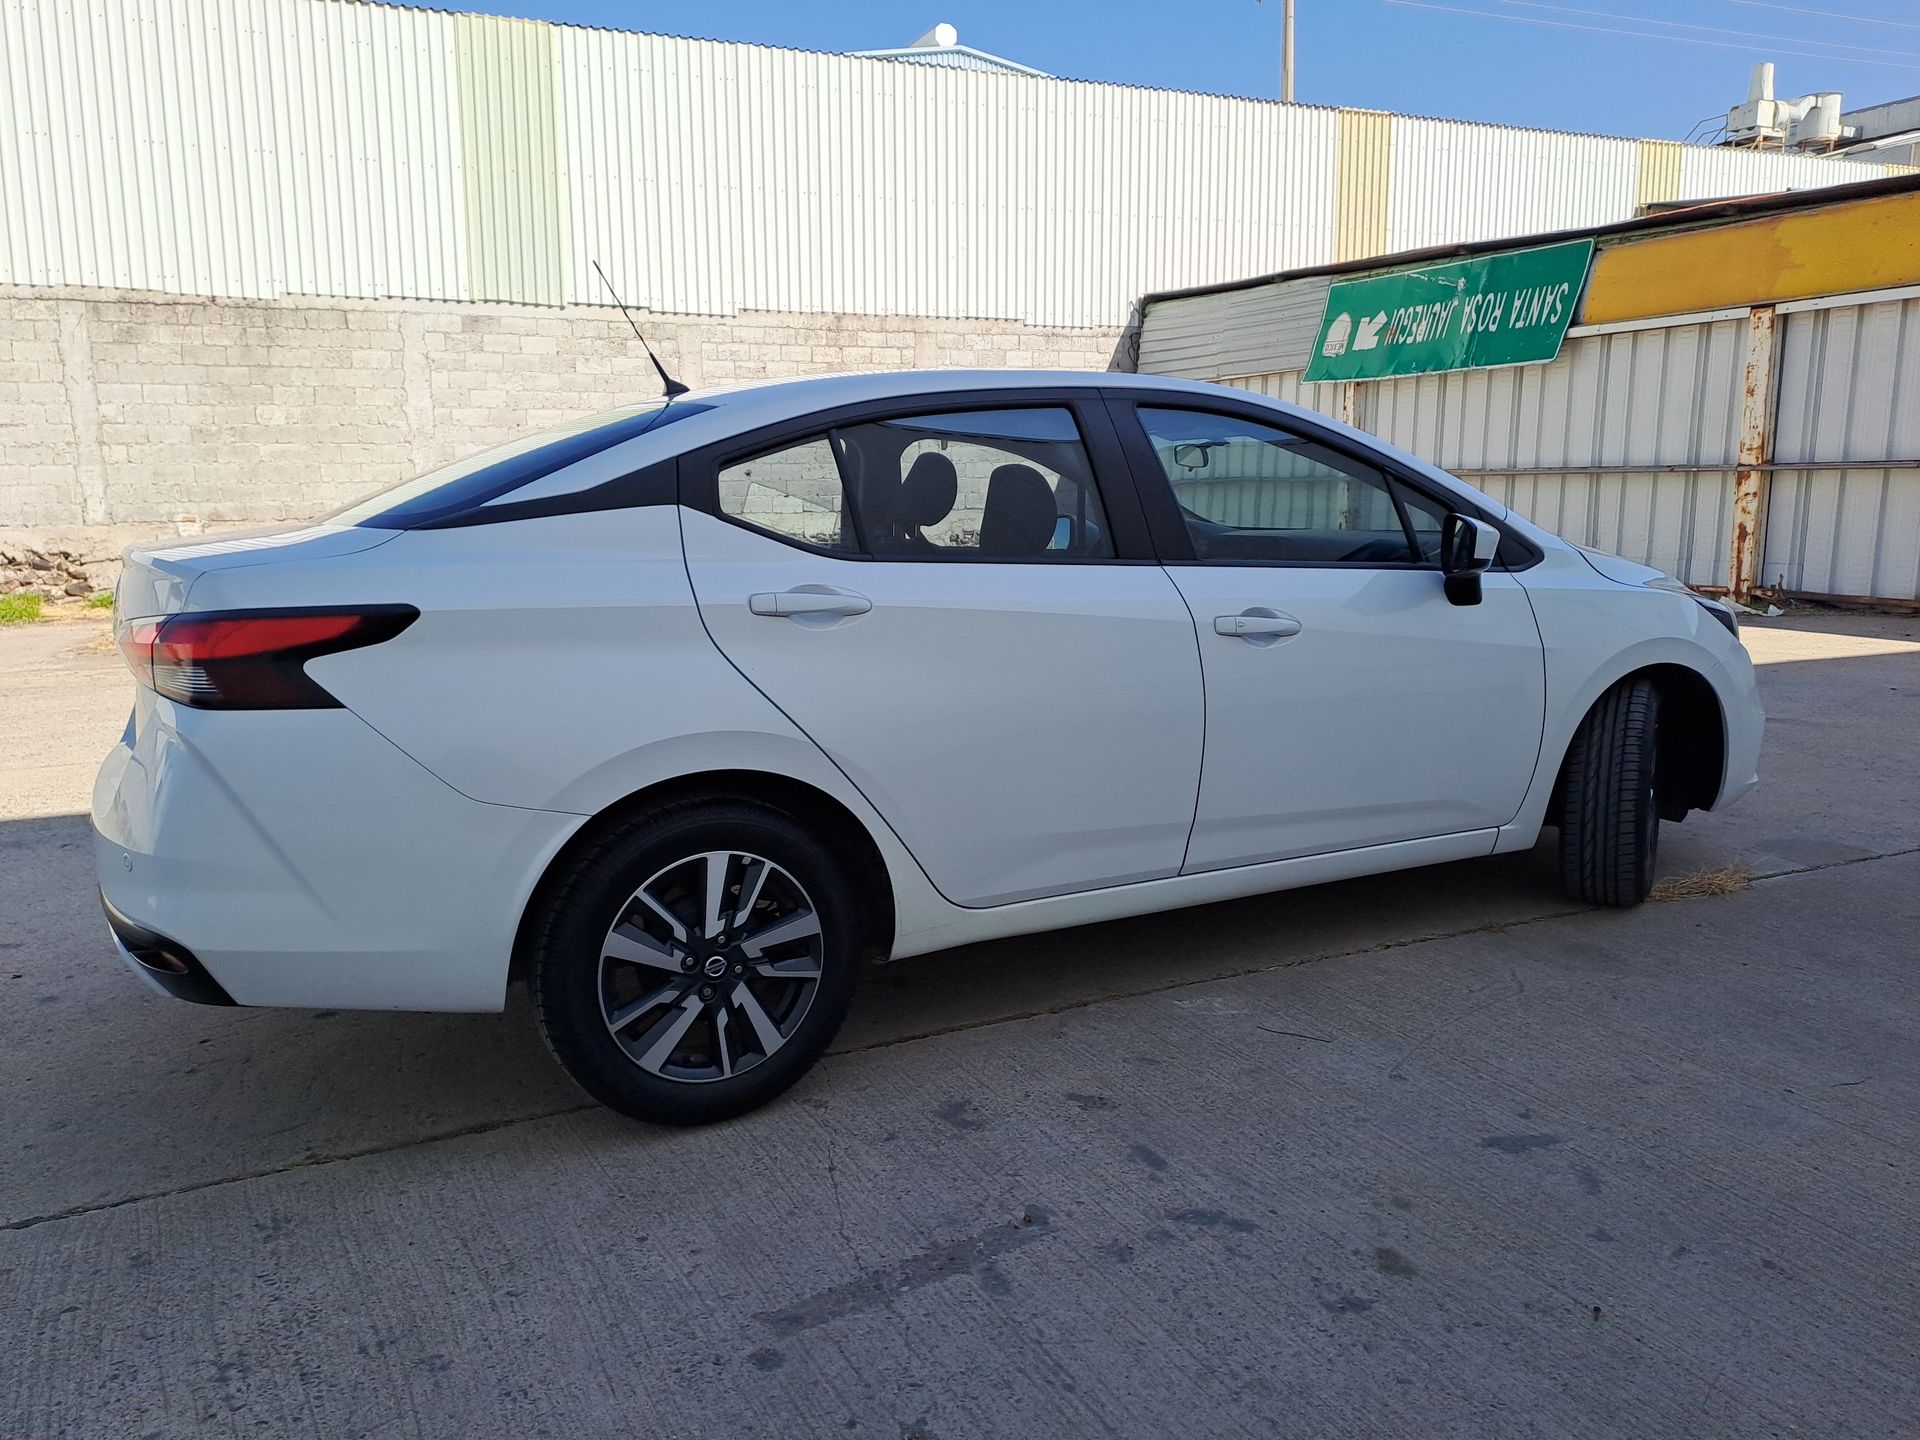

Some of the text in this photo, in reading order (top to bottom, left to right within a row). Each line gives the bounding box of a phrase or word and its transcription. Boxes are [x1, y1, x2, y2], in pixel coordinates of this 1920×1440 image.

[1384, 282, 1569, 346] SANTA ROSA JAUREGUI
